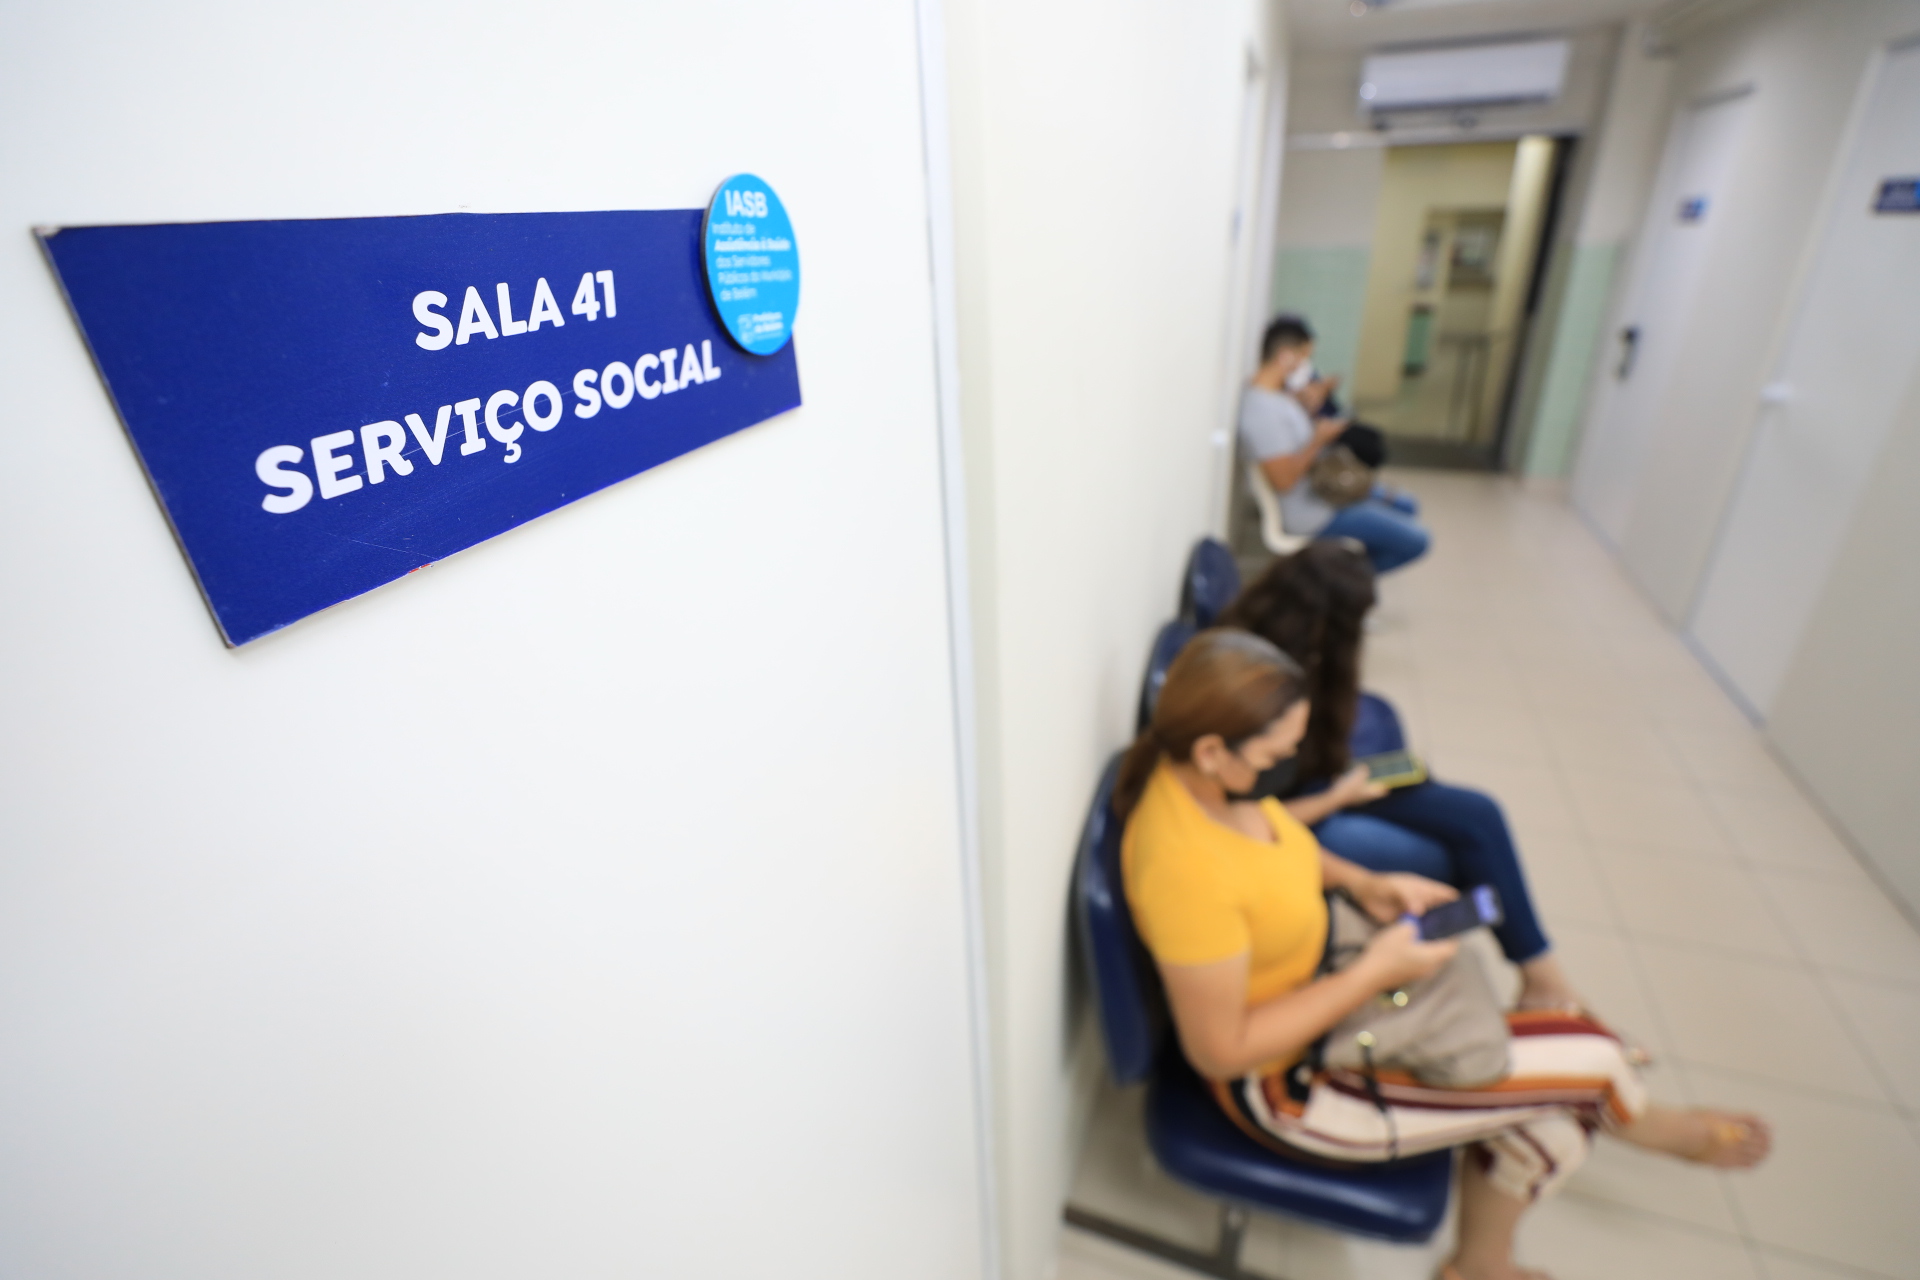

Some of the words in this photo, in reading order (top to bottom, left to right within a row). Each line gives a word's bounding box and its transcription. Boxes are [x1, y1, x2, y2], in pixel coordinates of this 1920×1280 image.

[725, 189, 768, 218] IASB
[413, 277, 566, 351] SALA
[571, 269, 617, 322] 41
[255, 380, 563, 514] SERVIÇO
[572, 339, 721, 419] SOCIAL
